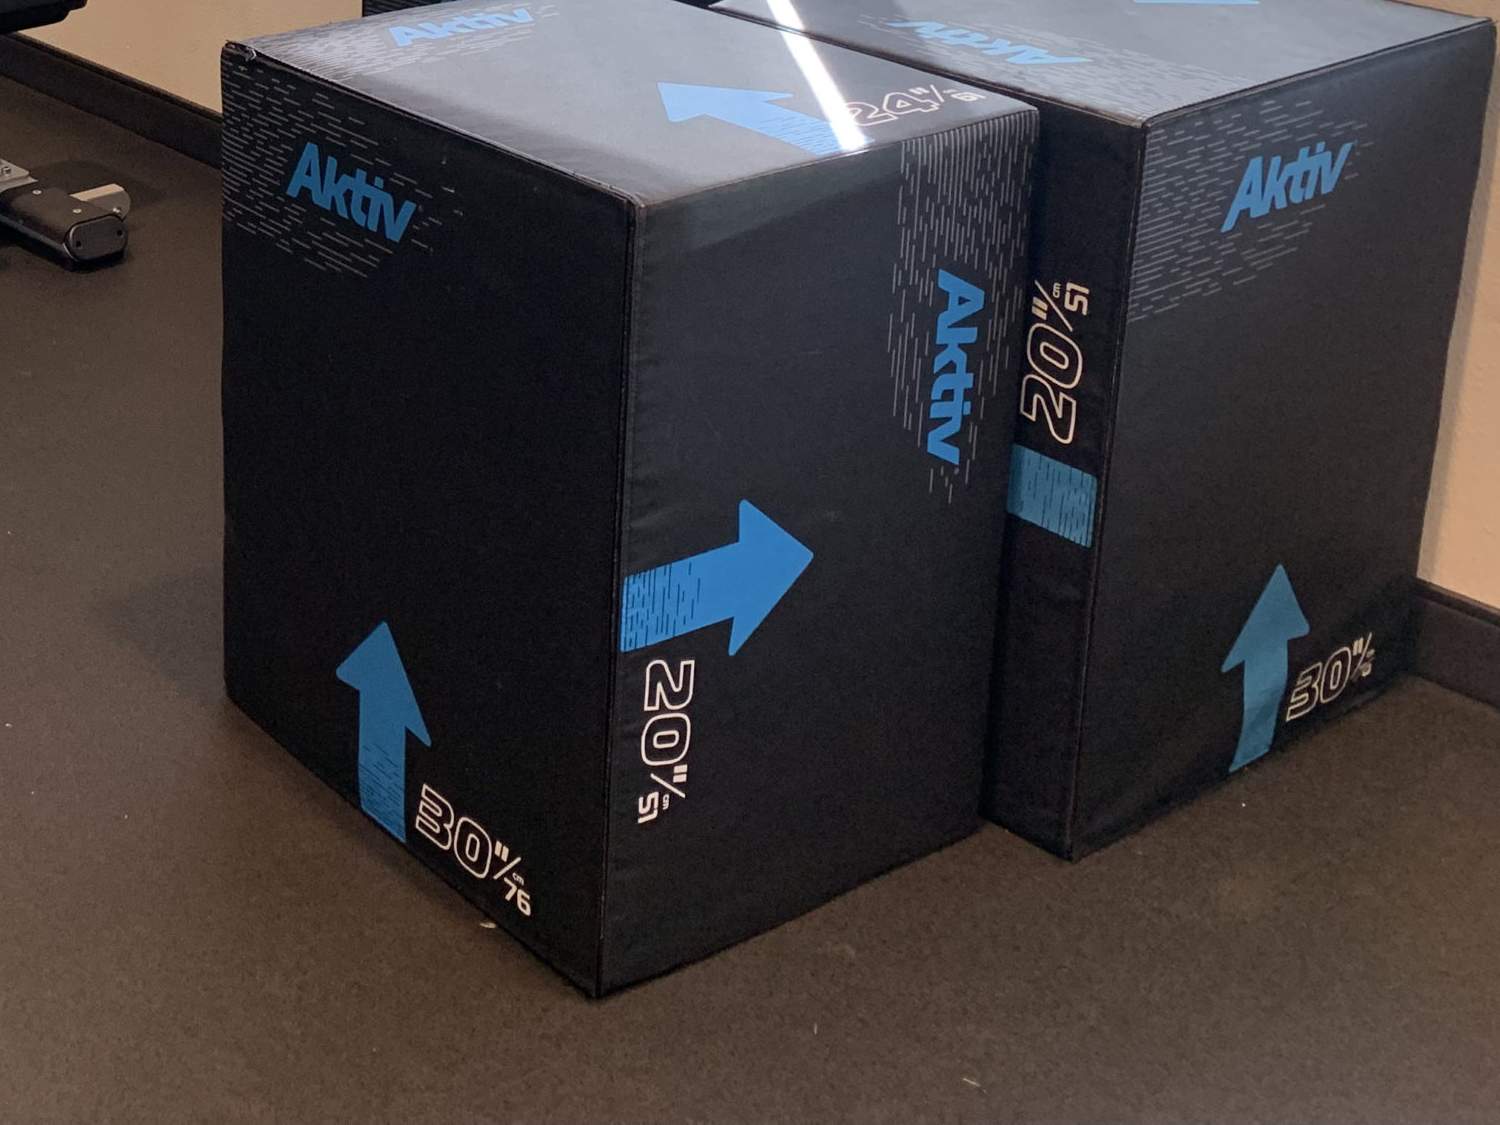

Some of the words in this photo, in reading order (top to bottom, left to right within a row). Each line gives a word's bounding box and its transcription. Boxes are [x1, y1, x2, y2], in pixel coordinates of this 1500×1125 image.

[388, 7, 534, 48] Aktiv
[884, 20, 1094, 66] Aktiv
[285, 141, 418, 244] Aktiv
[1220, 140, 1354, 233] Aktiv
[926, 268, 985, 467] Aktiv
